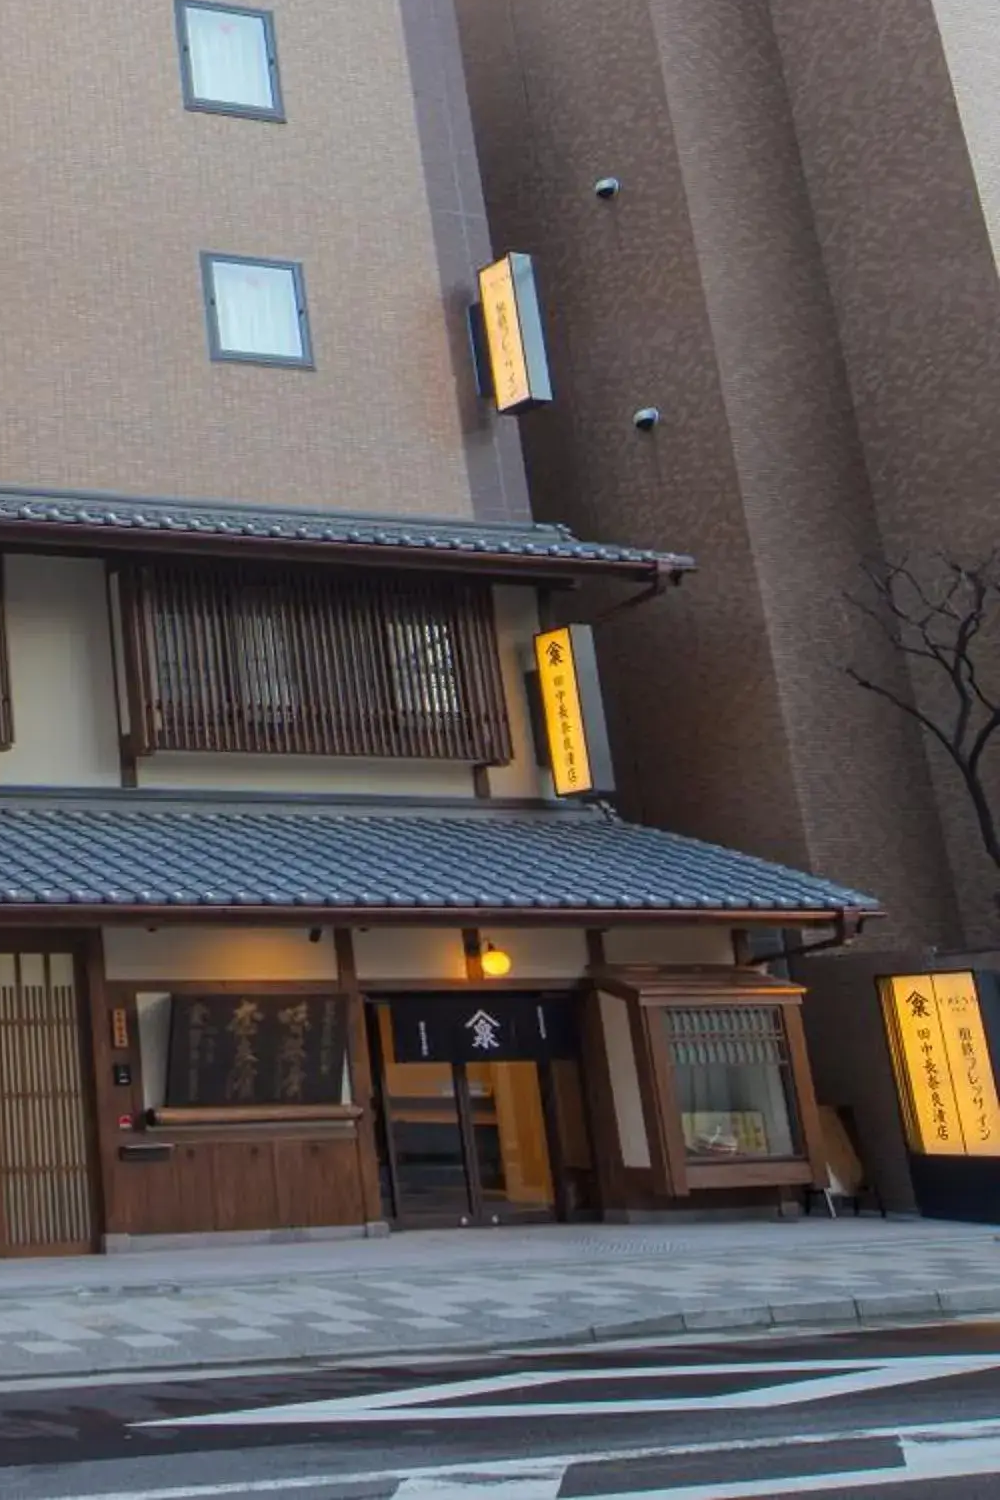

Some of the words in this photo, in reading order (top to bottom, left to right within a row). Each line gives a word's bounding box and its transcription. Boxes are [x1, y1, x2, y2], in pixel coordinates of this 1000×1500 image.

[917, 1027, 949, 1141] 田中長奈良漬店
